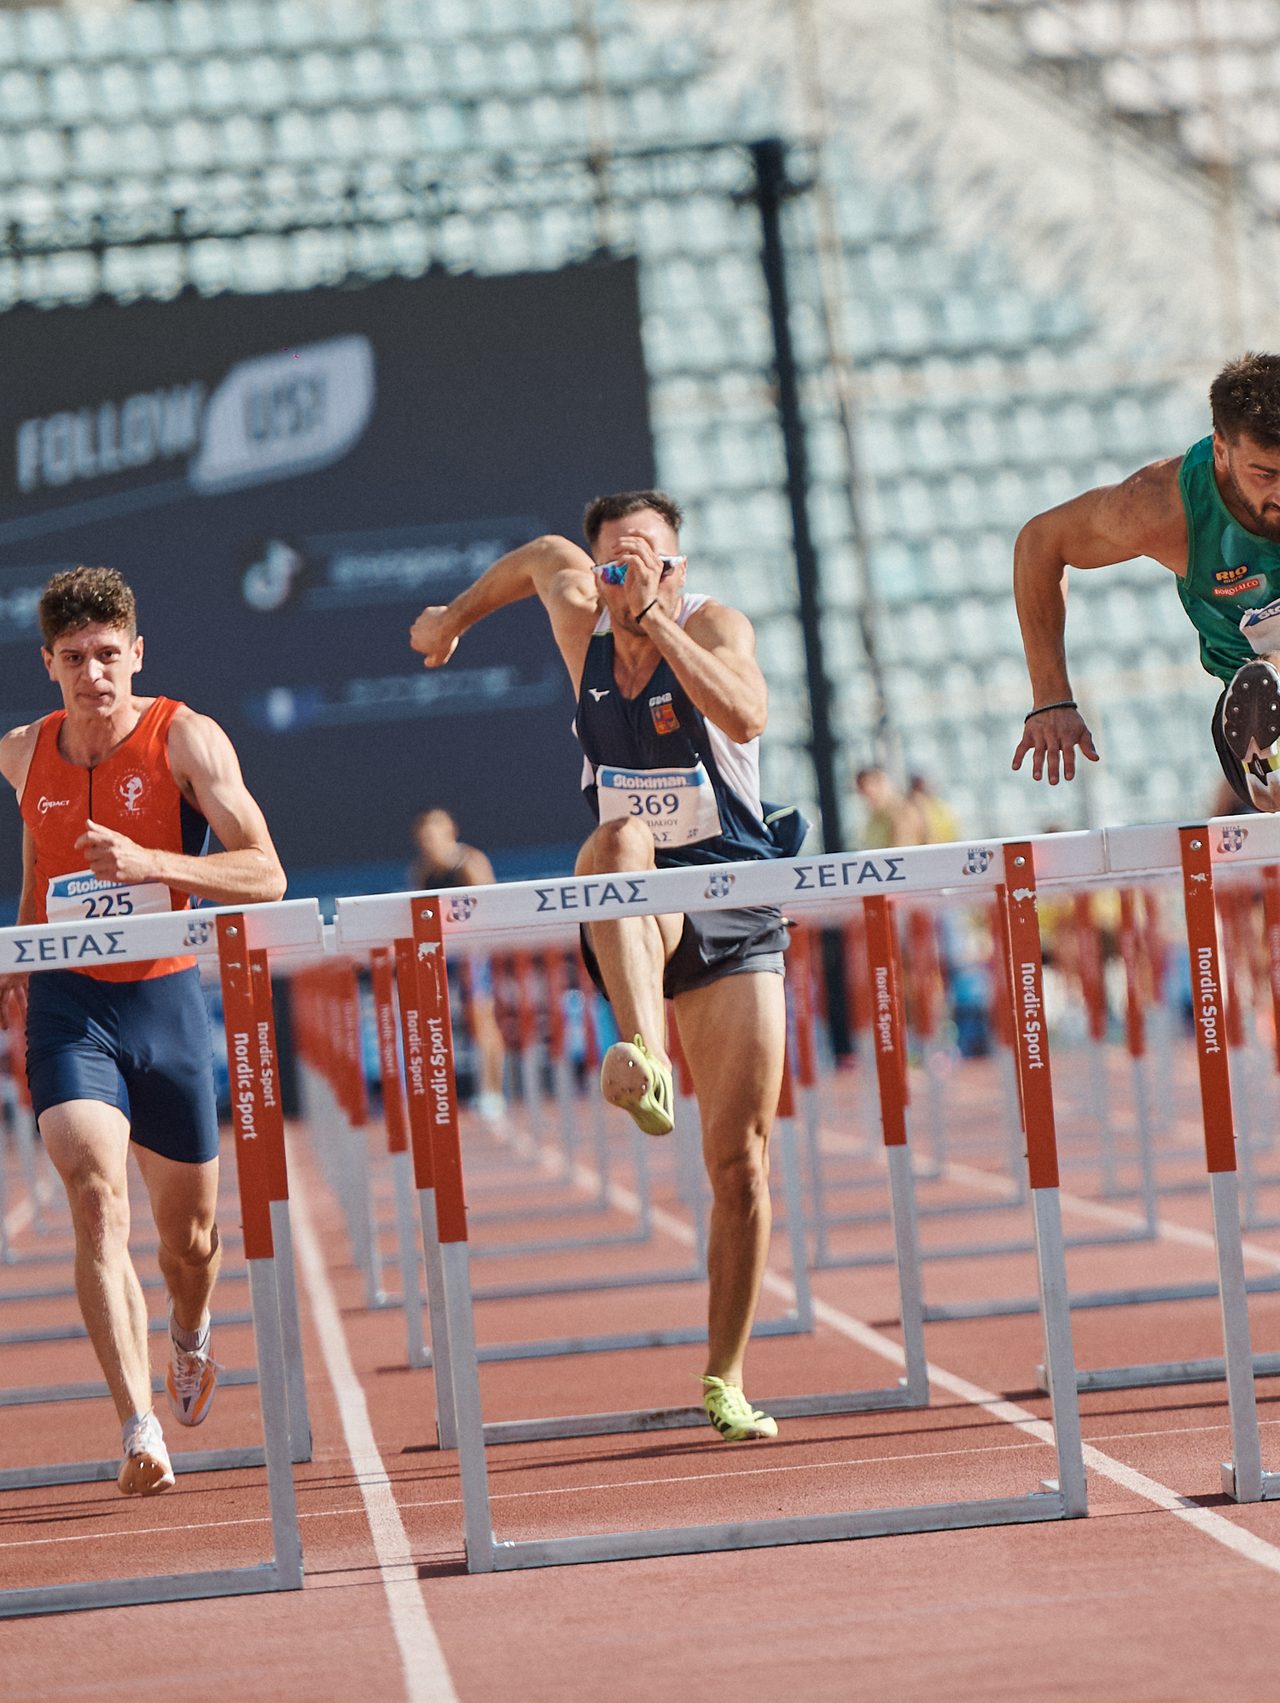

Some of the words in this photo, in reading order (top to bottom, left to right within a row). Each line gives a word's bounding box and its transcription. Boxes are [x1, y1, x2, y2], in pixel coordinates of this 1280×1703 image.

[17, 383, 203, 493] FOLLOW
[1215, 566, 1248, 580] RIO
[612, 773, 687, 790] Stoiximan
[628, 793, 680, 816] 369
[534, 879, 649, 913] ΣΕΓΑΣ
[793, 857, 907, 891] ΣΕΓΑΣ
[82, 892, 133, 918] 225
[13, 931, 127, 963] ΣΕΓΑΣ
[875, 966, 891, 1011] nordic
[1021, 962, 1041, 1018] nordic
[1198, 946, 1218, 1003] nordic
[257, 1021, 274, 1066] nordic
[406, 1009, 421, 1055] nordic
[426, 1016, 449, 1067] Sport
[877, 1012, 895, 1053] Sport
[1023, 1021, 1044, 1070] Sport
[1199, 1005, 1221, 1054] Sport
[233, 1032, 254, 1088] nordic
[408, 1056, 425, 1096] Sport
[258, 1068, 276, 1107] Sport
[430, 1068, 450, 1125] nordic
[238, 1091, 258, 1141] Sport
